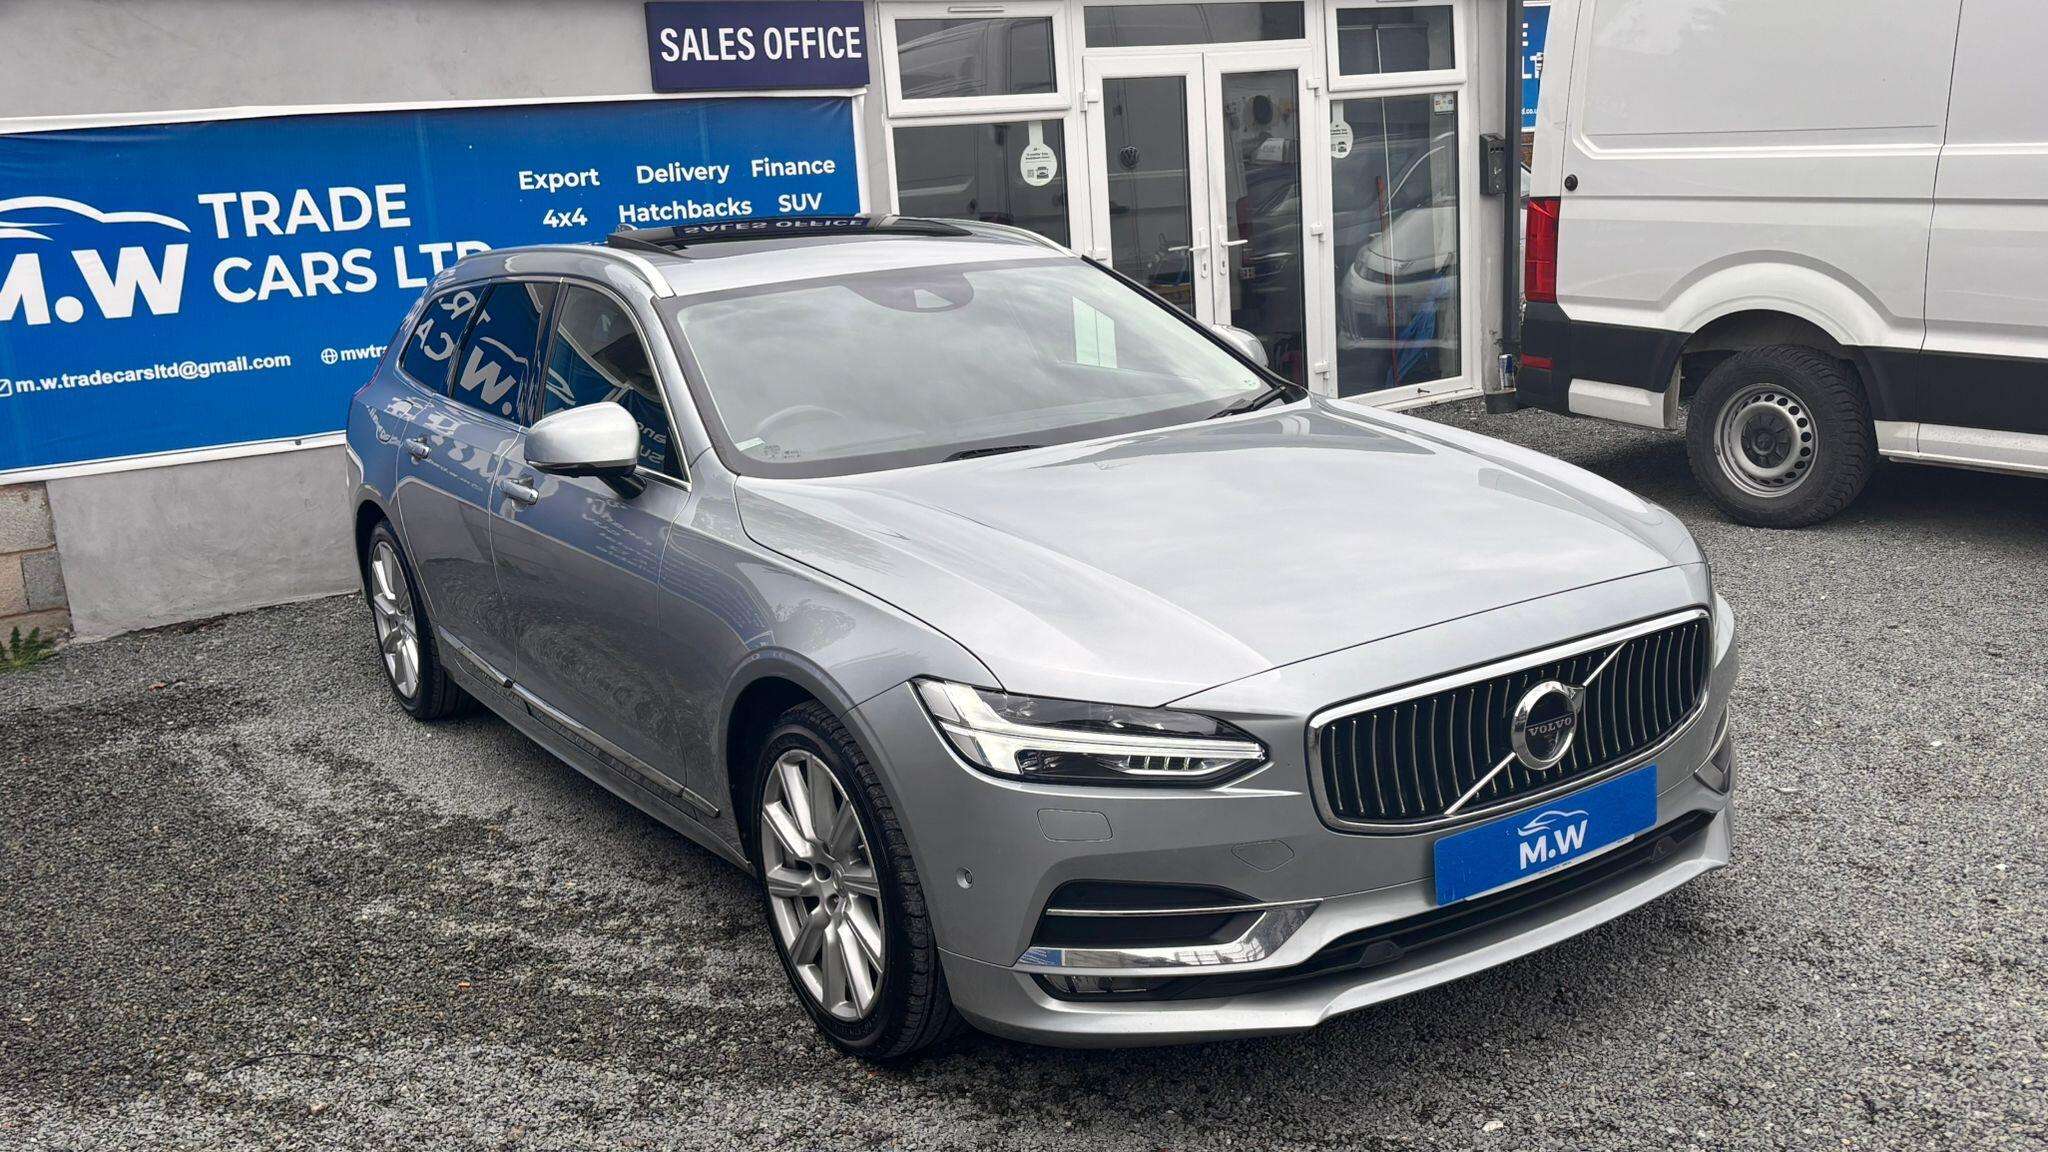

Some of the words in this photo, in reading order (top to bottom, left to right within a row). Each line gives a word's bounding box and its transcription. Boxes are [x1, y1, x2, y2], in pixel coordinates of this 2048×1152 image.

[660, 27, 756, 62] SALES
[763, 26, 862, 60] OFFICE
[518, 168, 600, 193] Export
[636, 163, 731, 186] Delivery
[750, 157, 836, 178] Finance
[197, 183, 411, 239] TRADE
[542, 207, 588, 229] 4x4
[618, 197, 753, 224] Hatchbacks
[777, 192, 822, 213] SUV
[212, 248, 378, 304] CARS
[15, 354, 292, 394] m.w.tradecarsltd@gmail.com
[1528, 717, 1571, 736] VOLVO
[1519, 819, 1588, 871] M.W
